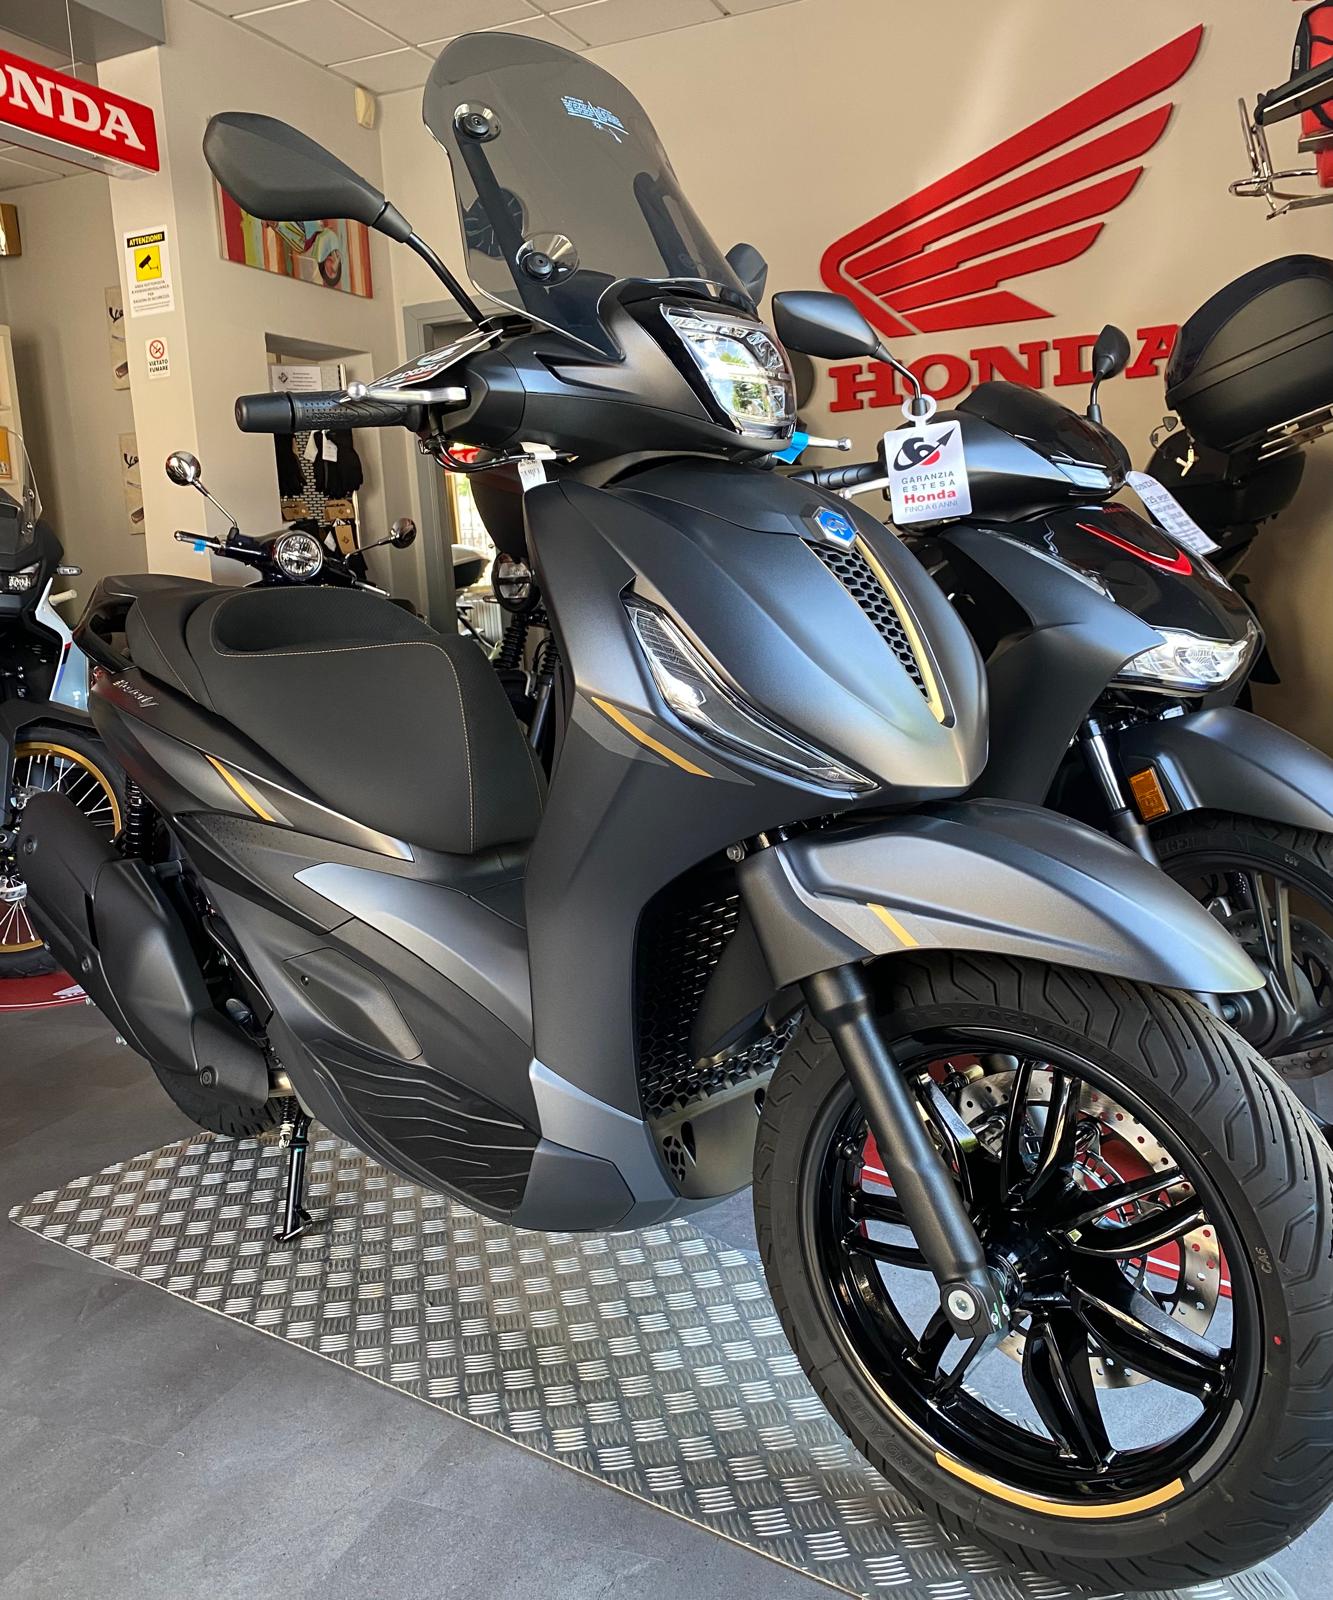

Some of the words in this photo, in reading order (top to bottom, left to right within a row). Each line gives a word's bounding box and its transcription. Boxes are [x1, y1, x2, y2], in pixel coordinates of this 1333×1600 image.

[0, 64, 146, 151] NDA
[149, 365, 168, 373] FUMARE
[901, 470, 955, 485] GARANZIA
[902, 479, 956, 493] ESTESA
[904, 489, 957, 504] Honda
[904, 503, 925, 513] FINO
